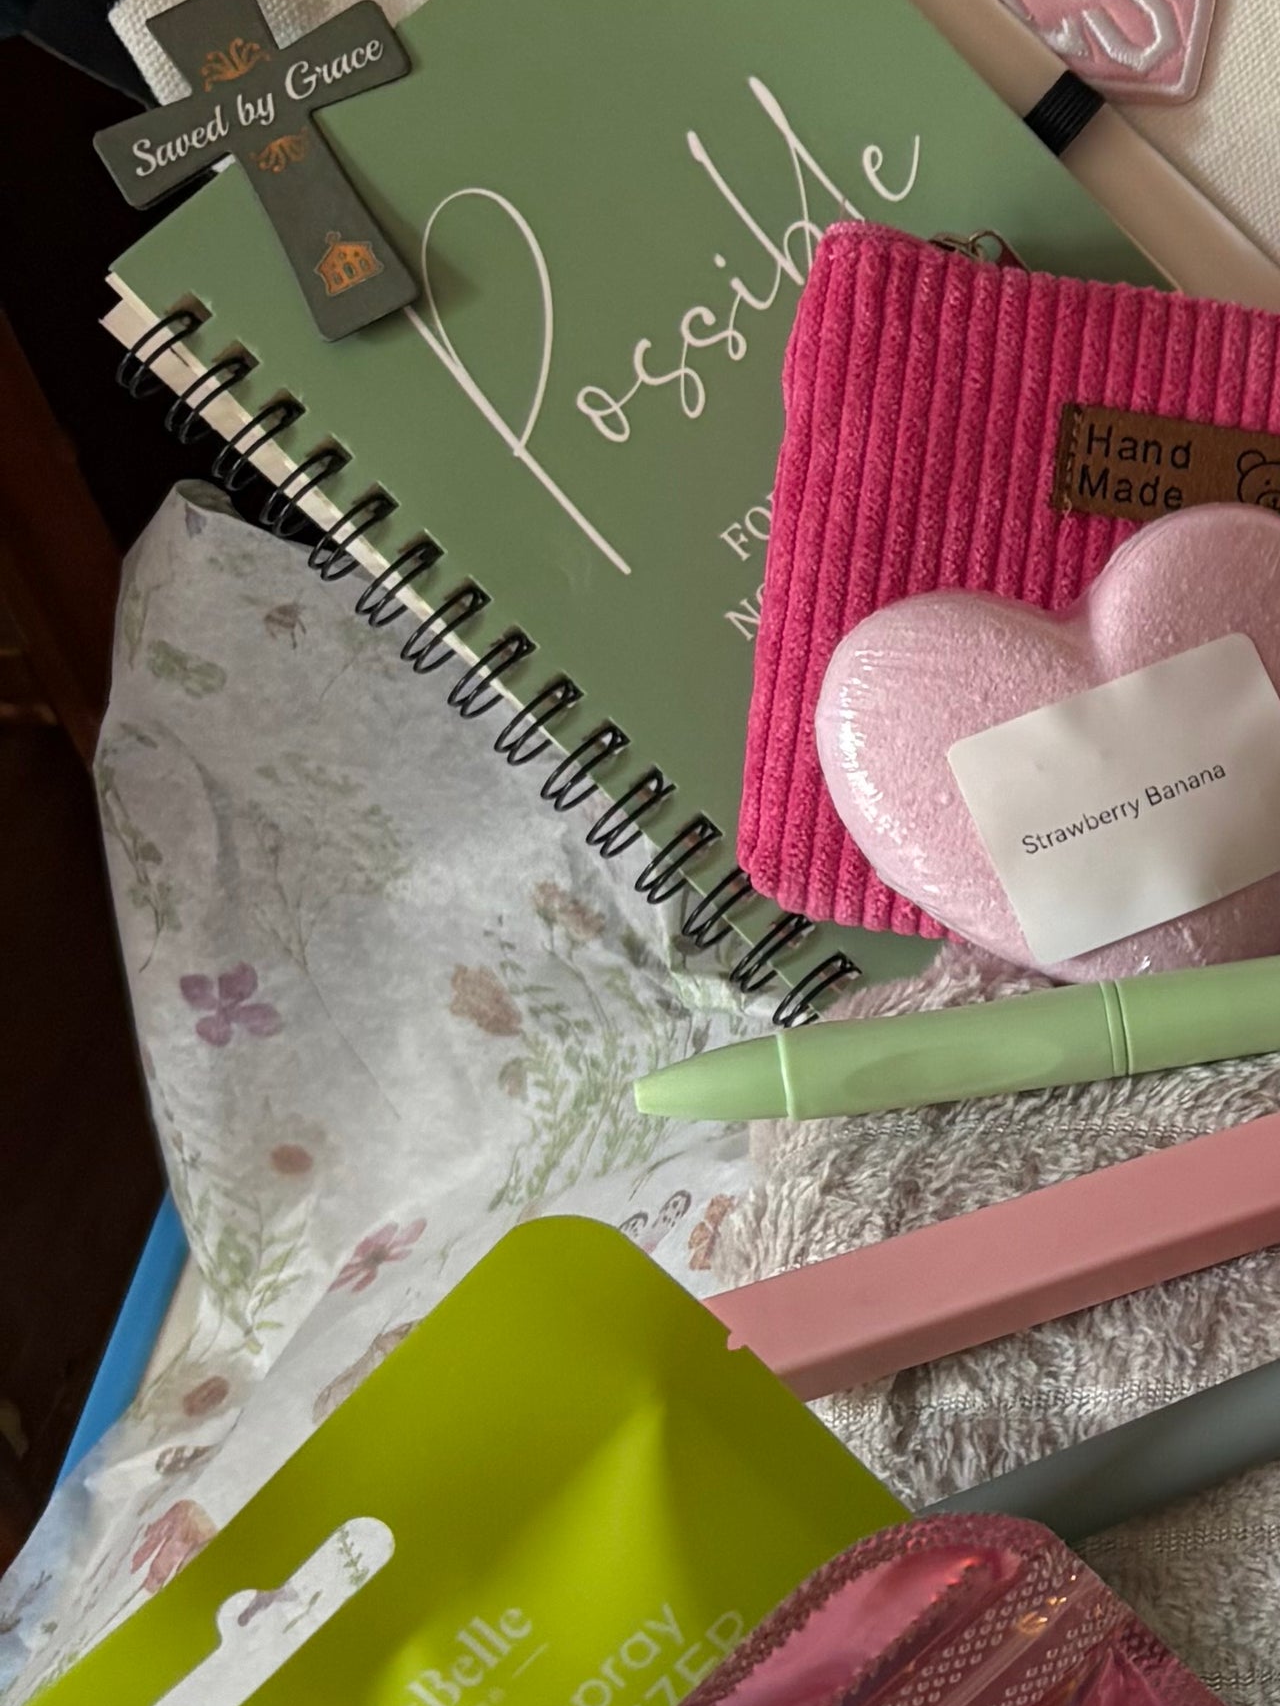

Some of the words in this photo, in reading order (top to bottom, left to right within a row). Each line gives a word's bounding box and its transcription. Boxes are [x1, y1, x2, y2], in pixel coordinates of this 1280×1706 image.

[132, 105, 229, 177] Saved
[236, 90, 276, 126] by
[285, 34, 384, 104] Grace
[1087, 423, 1192, 469] Hand
[1078, 464, 1183, 510] Made
[1020, 796, 1141, 856] Strawberry
[1145, 761, 1227, 809] Banana
